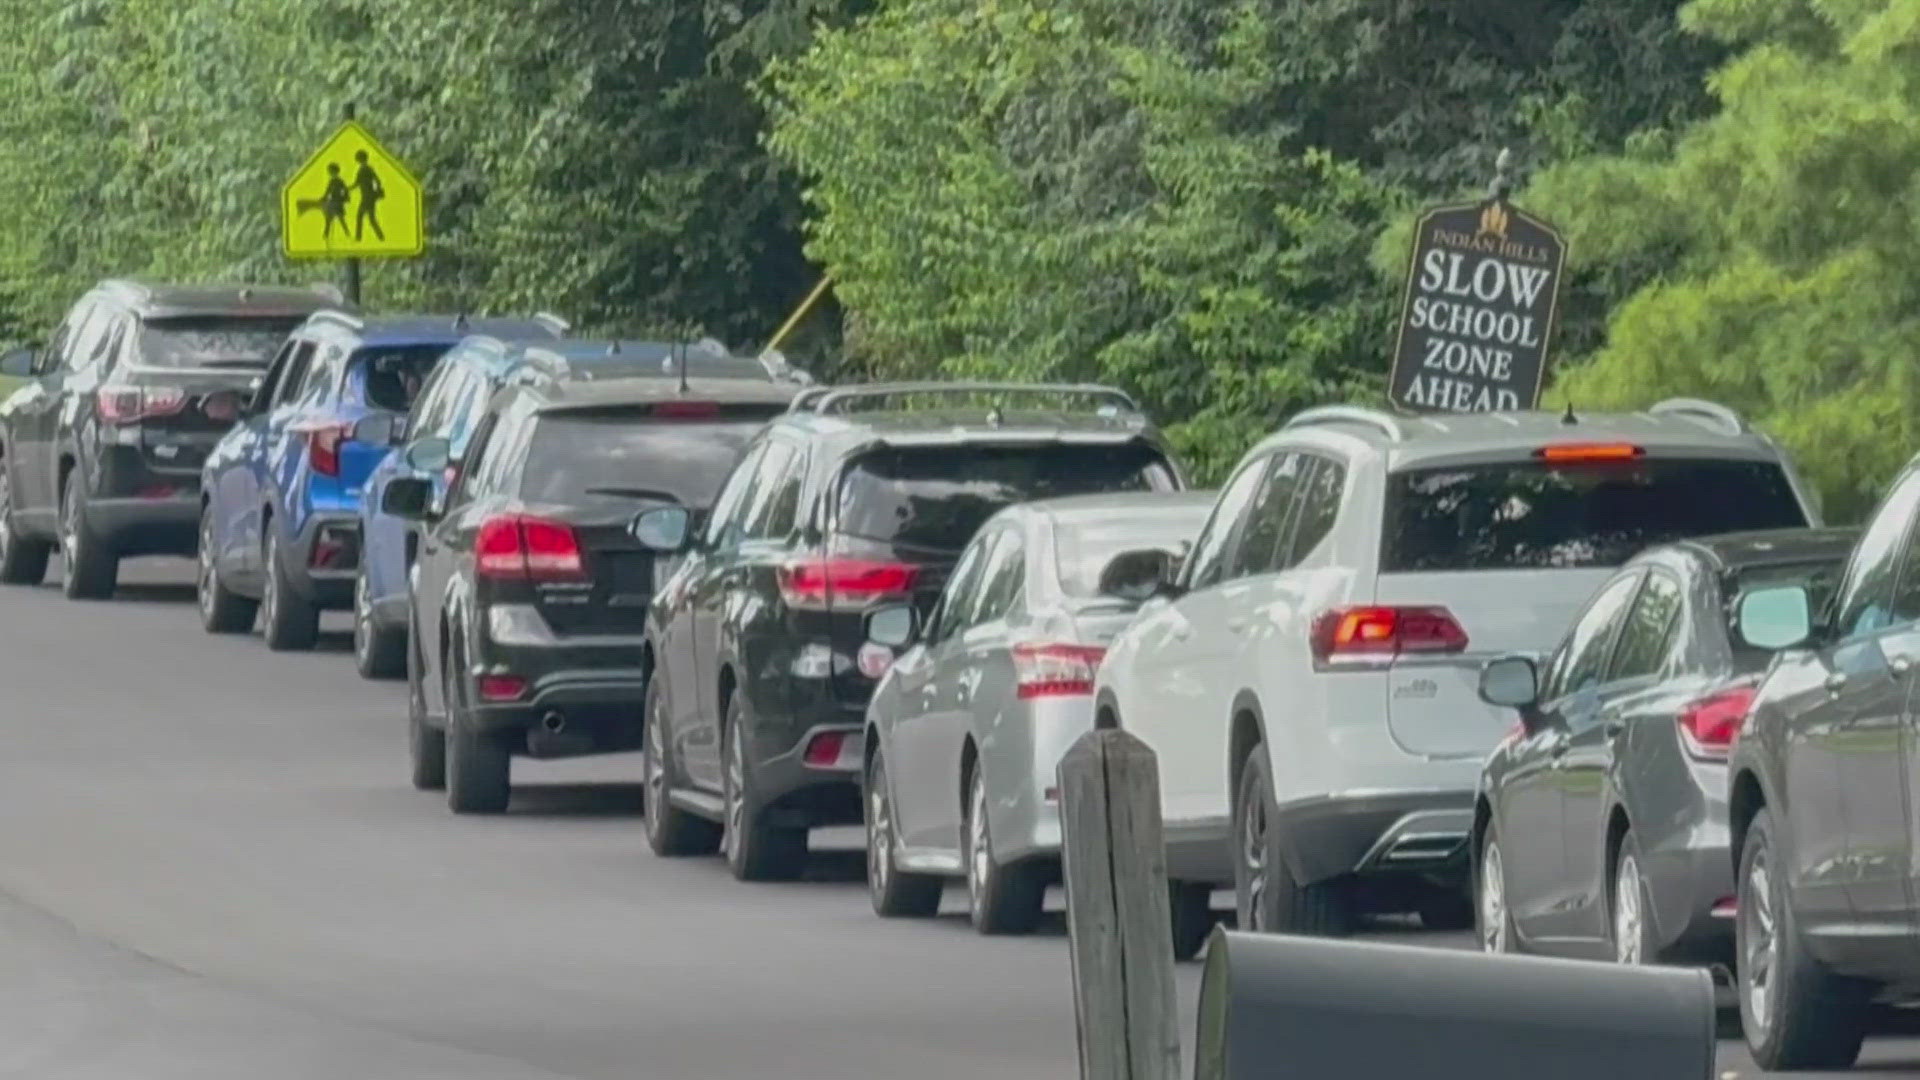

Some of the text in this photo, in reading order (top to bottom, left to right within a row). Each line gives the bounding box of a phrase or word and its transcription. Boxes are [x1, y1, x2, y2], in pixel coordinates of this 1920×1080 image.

[1433, 228, 1495, 253] INDIAN
[1420, 248, 1550, 309] SLOW
[1410, 296, 1539, 348] SCHOOL
[1423, 337, 1513, 380] ZONE
[1403, 372, 1520, 413] AHEAD
